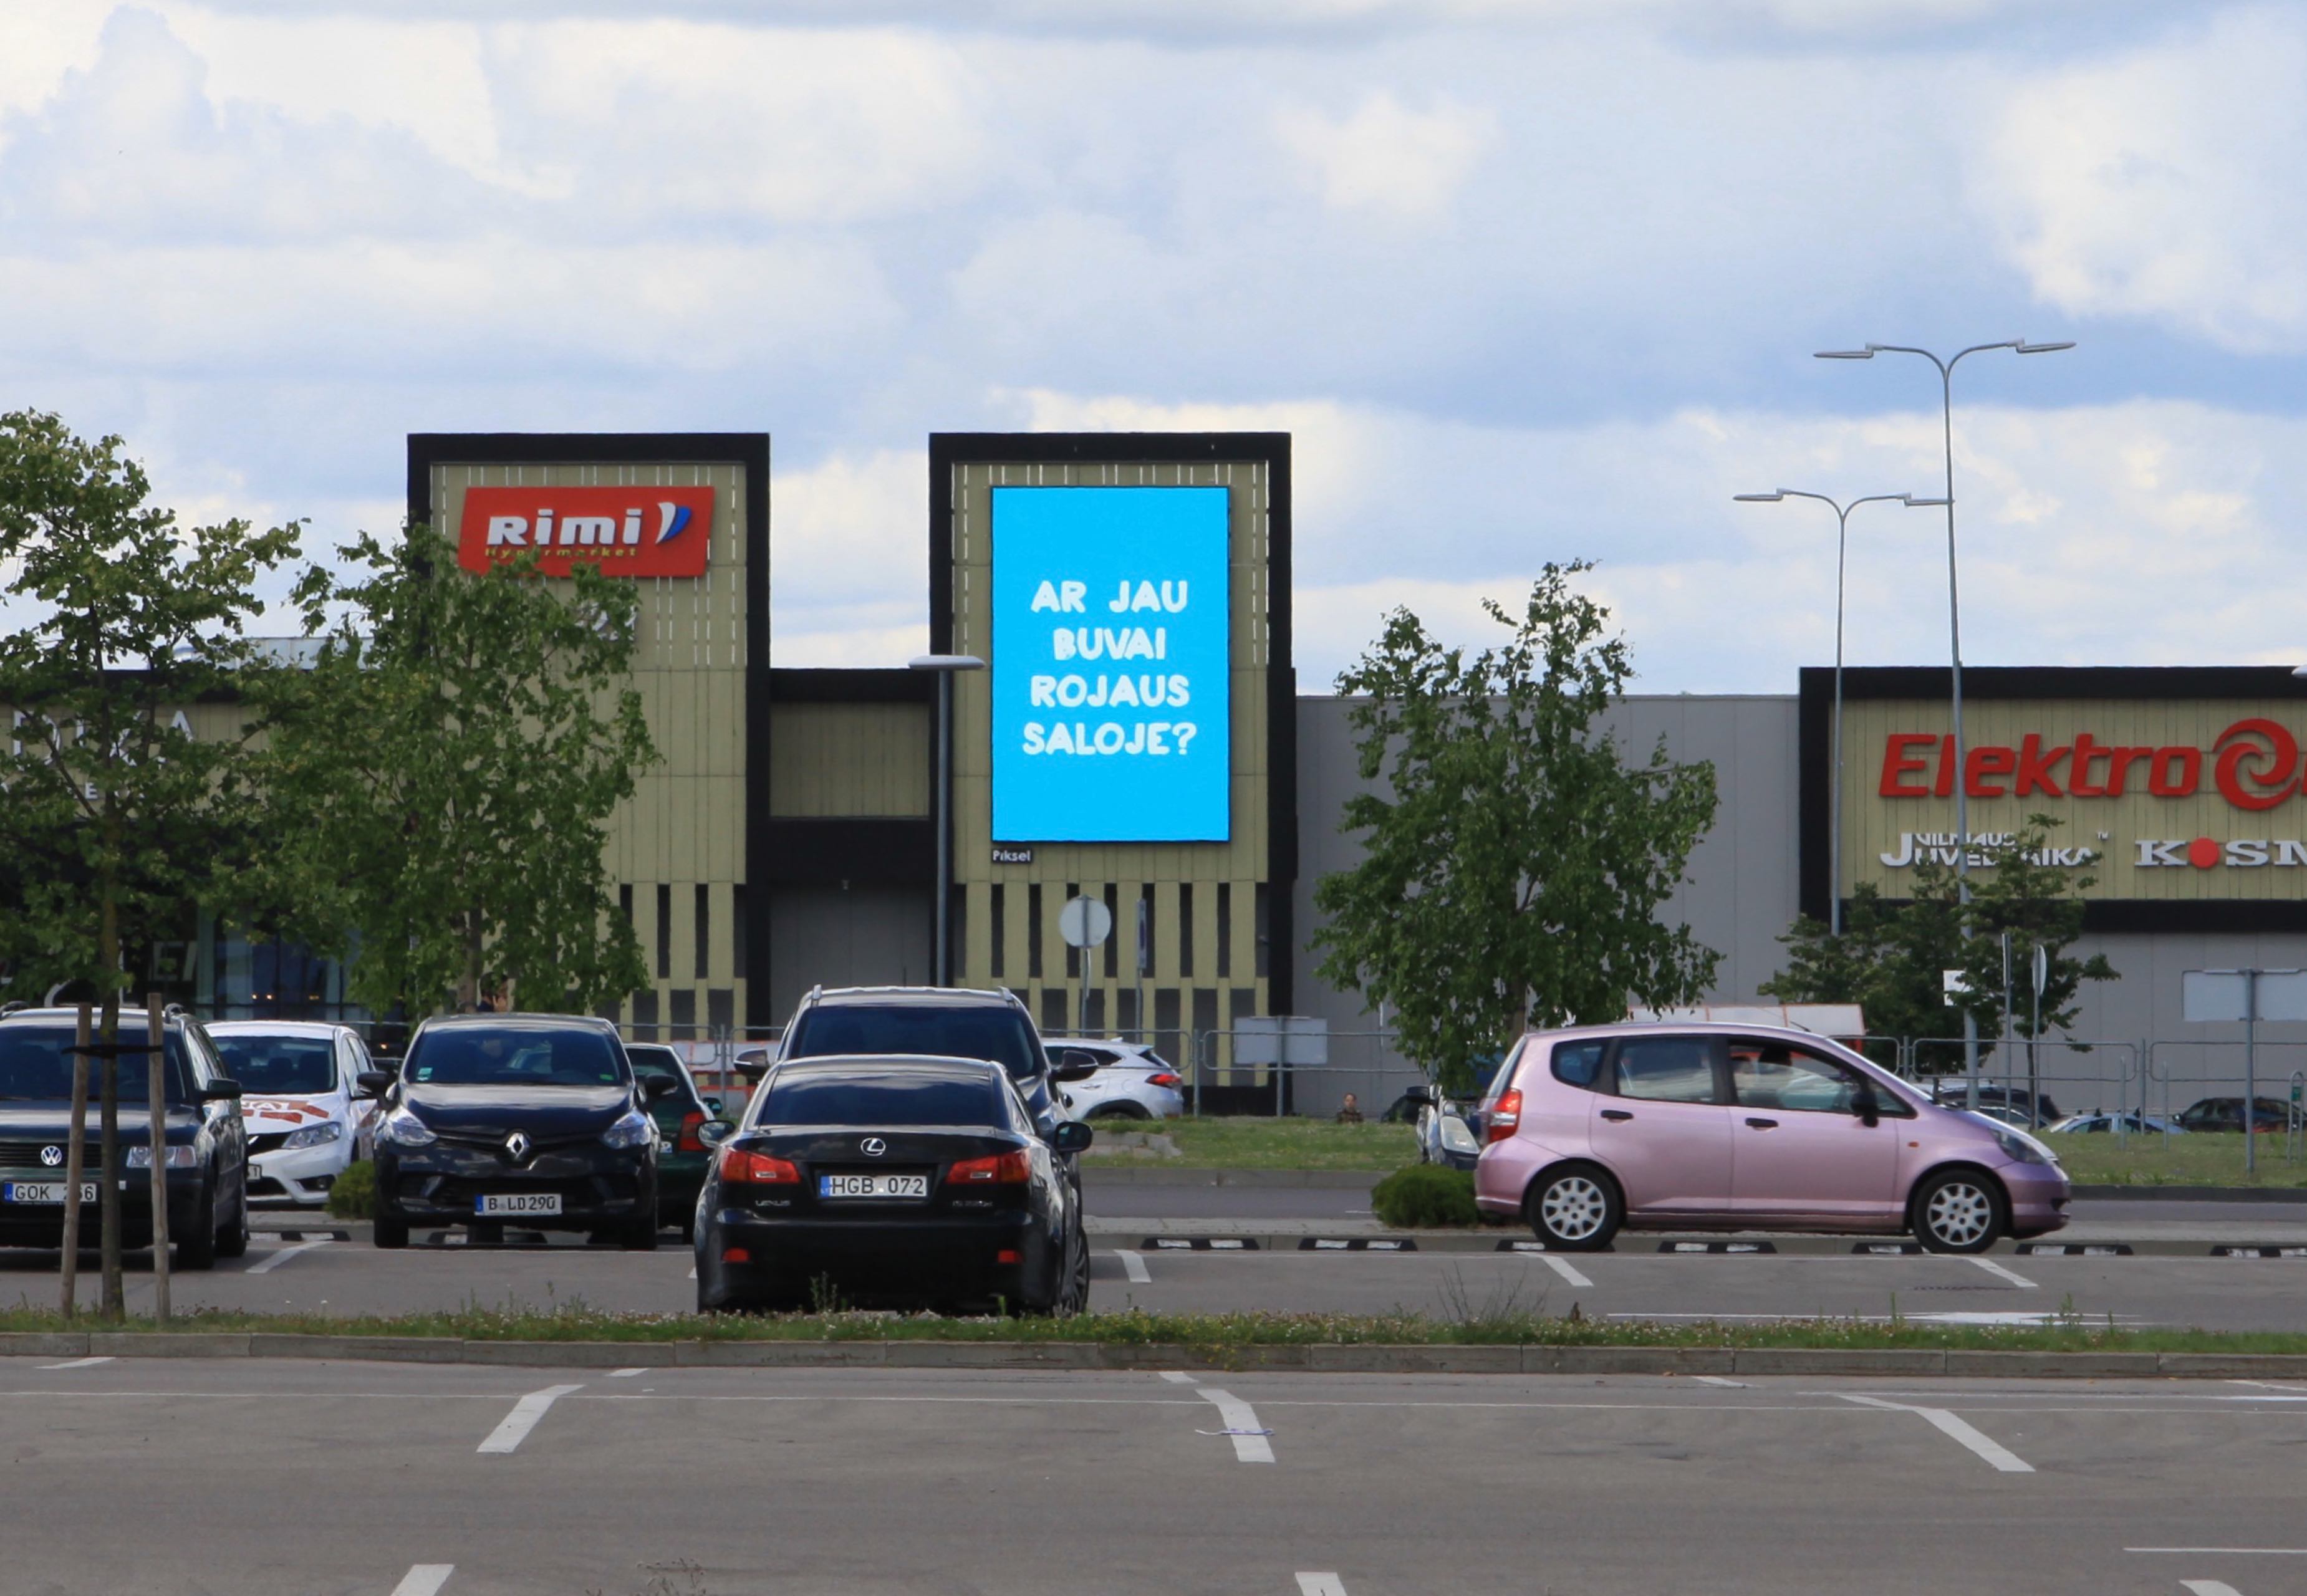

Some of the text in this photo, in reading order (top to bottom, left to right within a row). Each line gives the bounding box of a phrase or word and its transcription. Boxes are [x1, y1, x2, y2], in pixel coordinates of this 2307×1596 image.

[486, 509, 642, 546] Rimi
[484, 547, 637, 559] Hyprmarket
[1031, 580, 1188, 613] AR JAU
[1052, 627, 1166, 661] BUVAI
[1030, 675, 1190, 708] ROJAUS
[1022, 722, 1197, 756] SALOJE?
[993, 850, 1031, 862] Piksel
[1879, 832, 2101, 867] JUVELRIKA
[15, 1185, 50, 1200] GOK
[832, 1177, 874, 1194] HGB
[888, 1177, 924, 1194] 072
[488, 1196, 556, 1211] B LD 290
